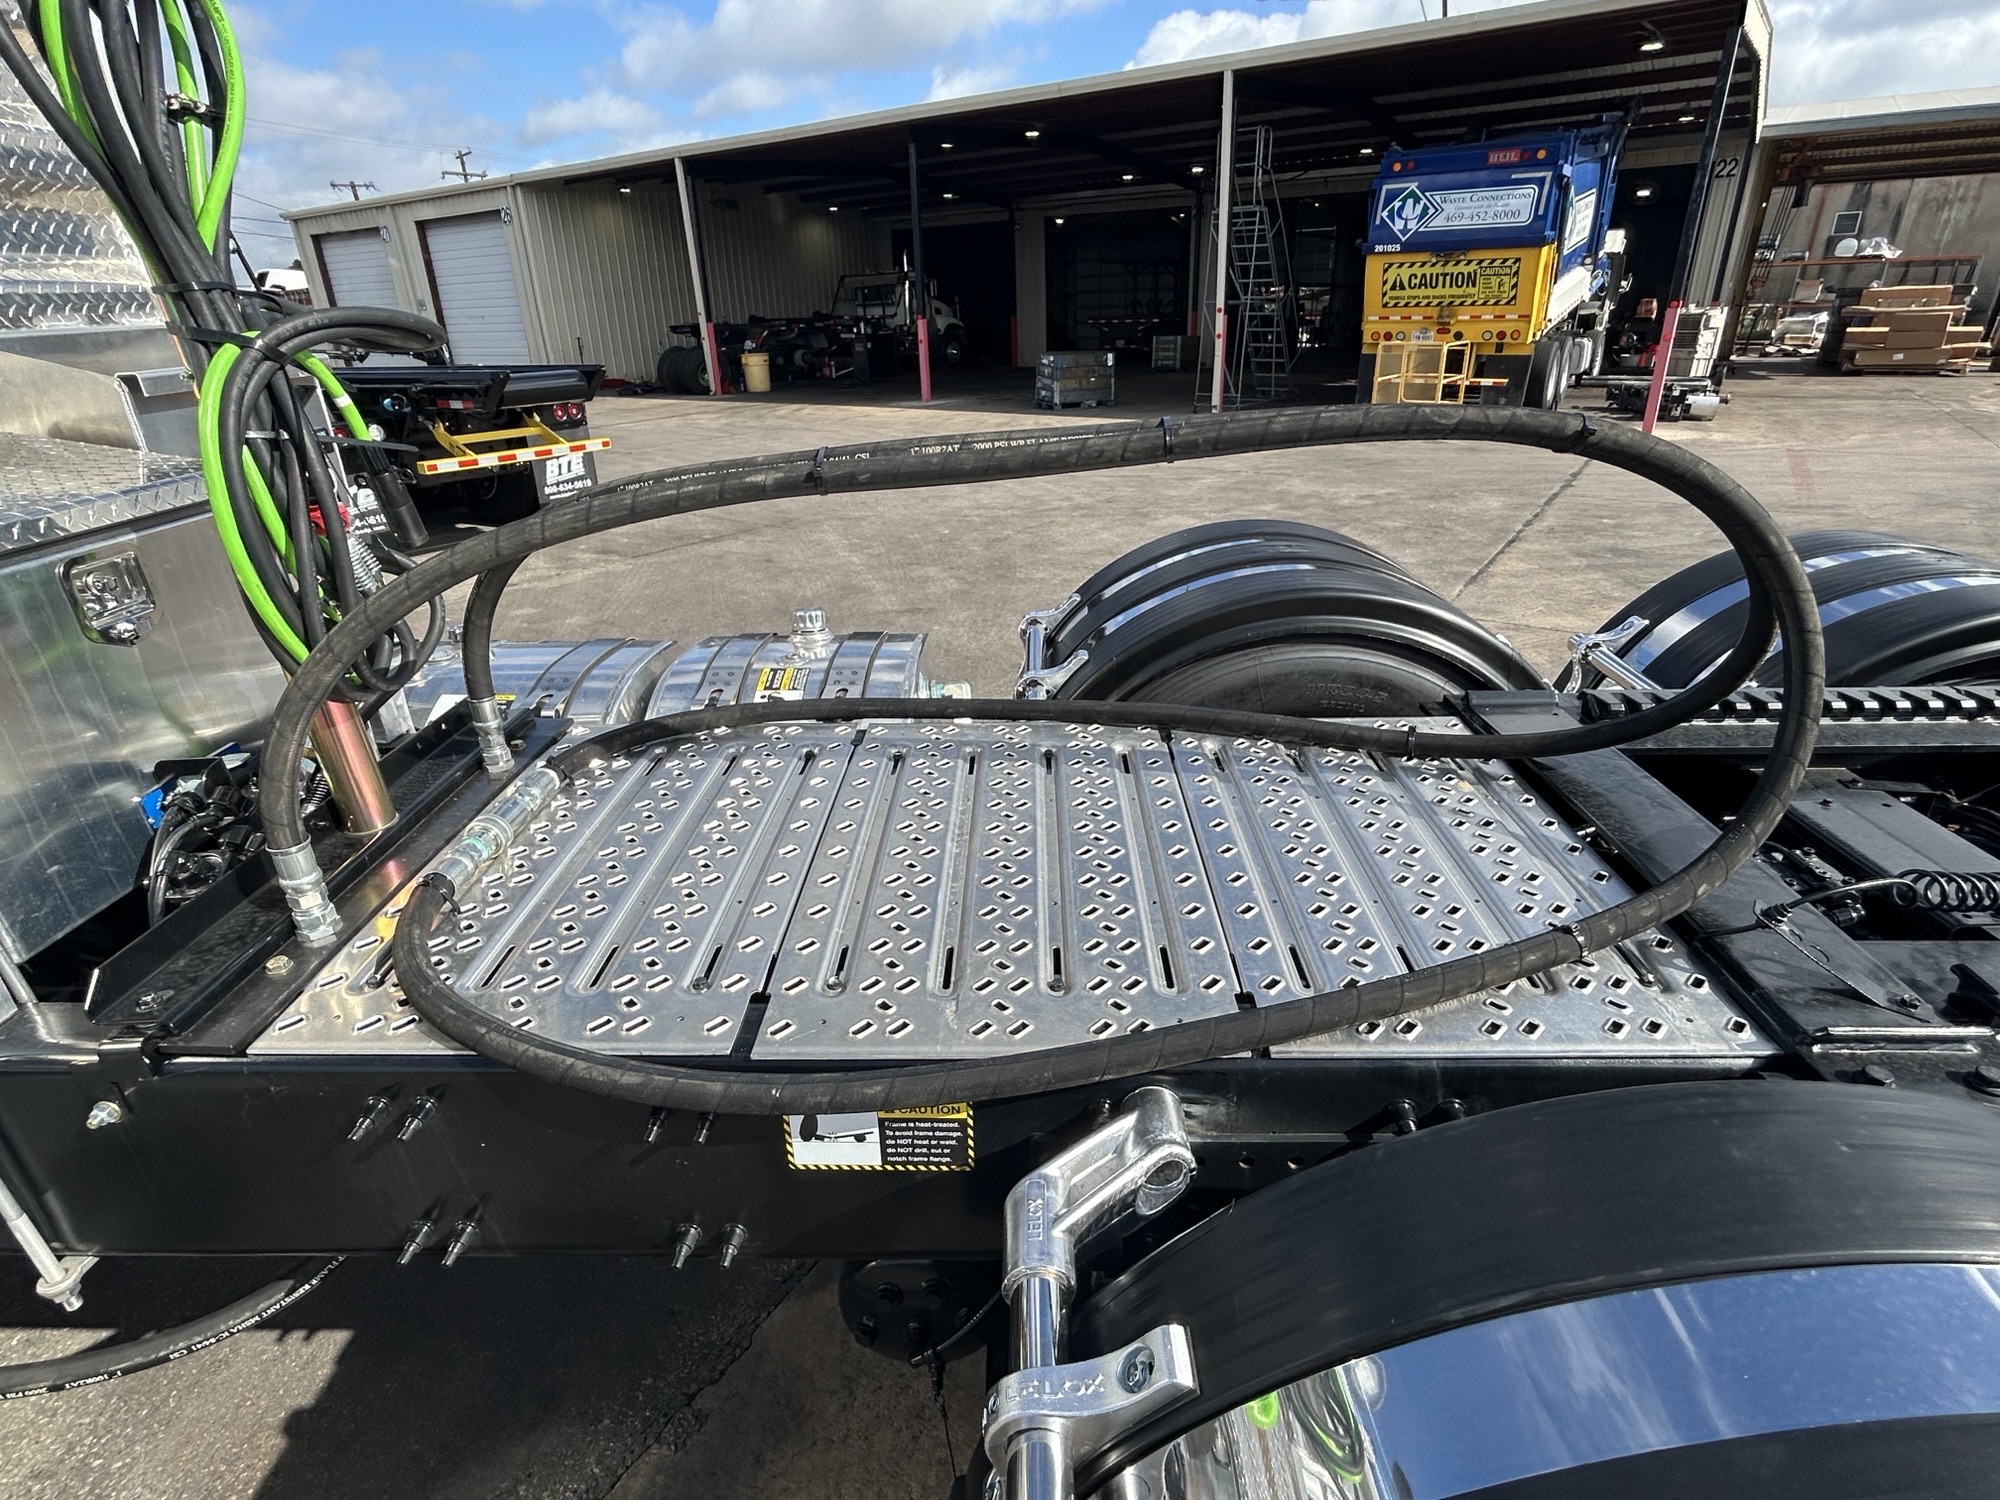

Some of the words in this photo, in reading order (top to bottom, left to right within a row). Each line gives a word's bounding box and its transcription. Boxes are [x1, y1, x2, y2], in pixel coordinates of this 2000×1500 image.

[1489, 151, 1518, 163] HEIL
[1714, 157, 1738, 179] 22
[1439, 194, 1467, 205] WASTE
[1469, 191, 1532, 203] CONNECTIONS
[1444, 209, 1521, 223] 469-452-8000
[1374, 243, 1401, 252] 201025
[1480, 266, 1511, 276] CAUTION
[1407, 270, 1478, 290] CAUTION
[1027, 1198, 1044, 1242] LELOX
[1004, 1372, 1105, 1404] LELOX
